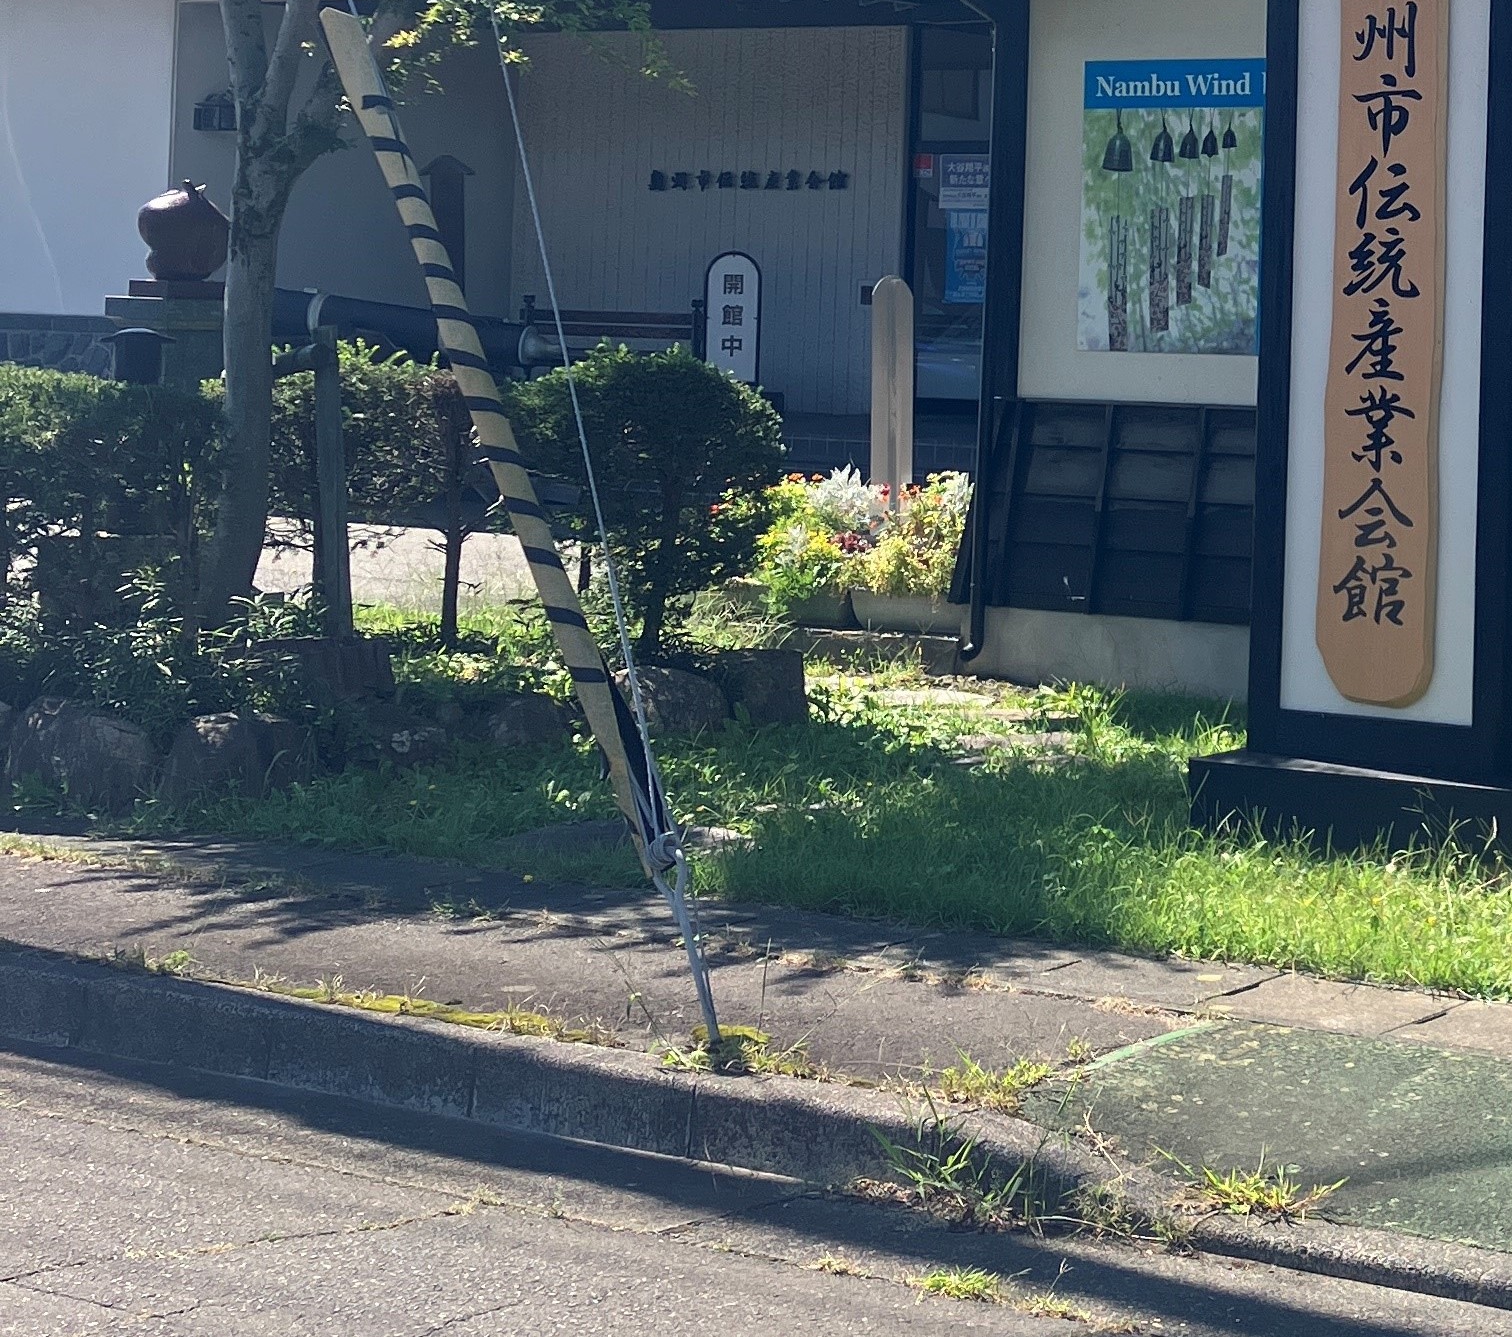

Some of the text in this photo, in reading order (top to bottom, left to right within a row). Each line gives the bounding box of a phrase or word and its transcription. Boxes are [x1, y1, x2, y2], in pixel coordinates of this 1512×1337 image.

[1095, 74, 1181, 98] Nambu
[1185, 71, 1252, 96] Wind
[721, 273, 744, 358] 開館中
